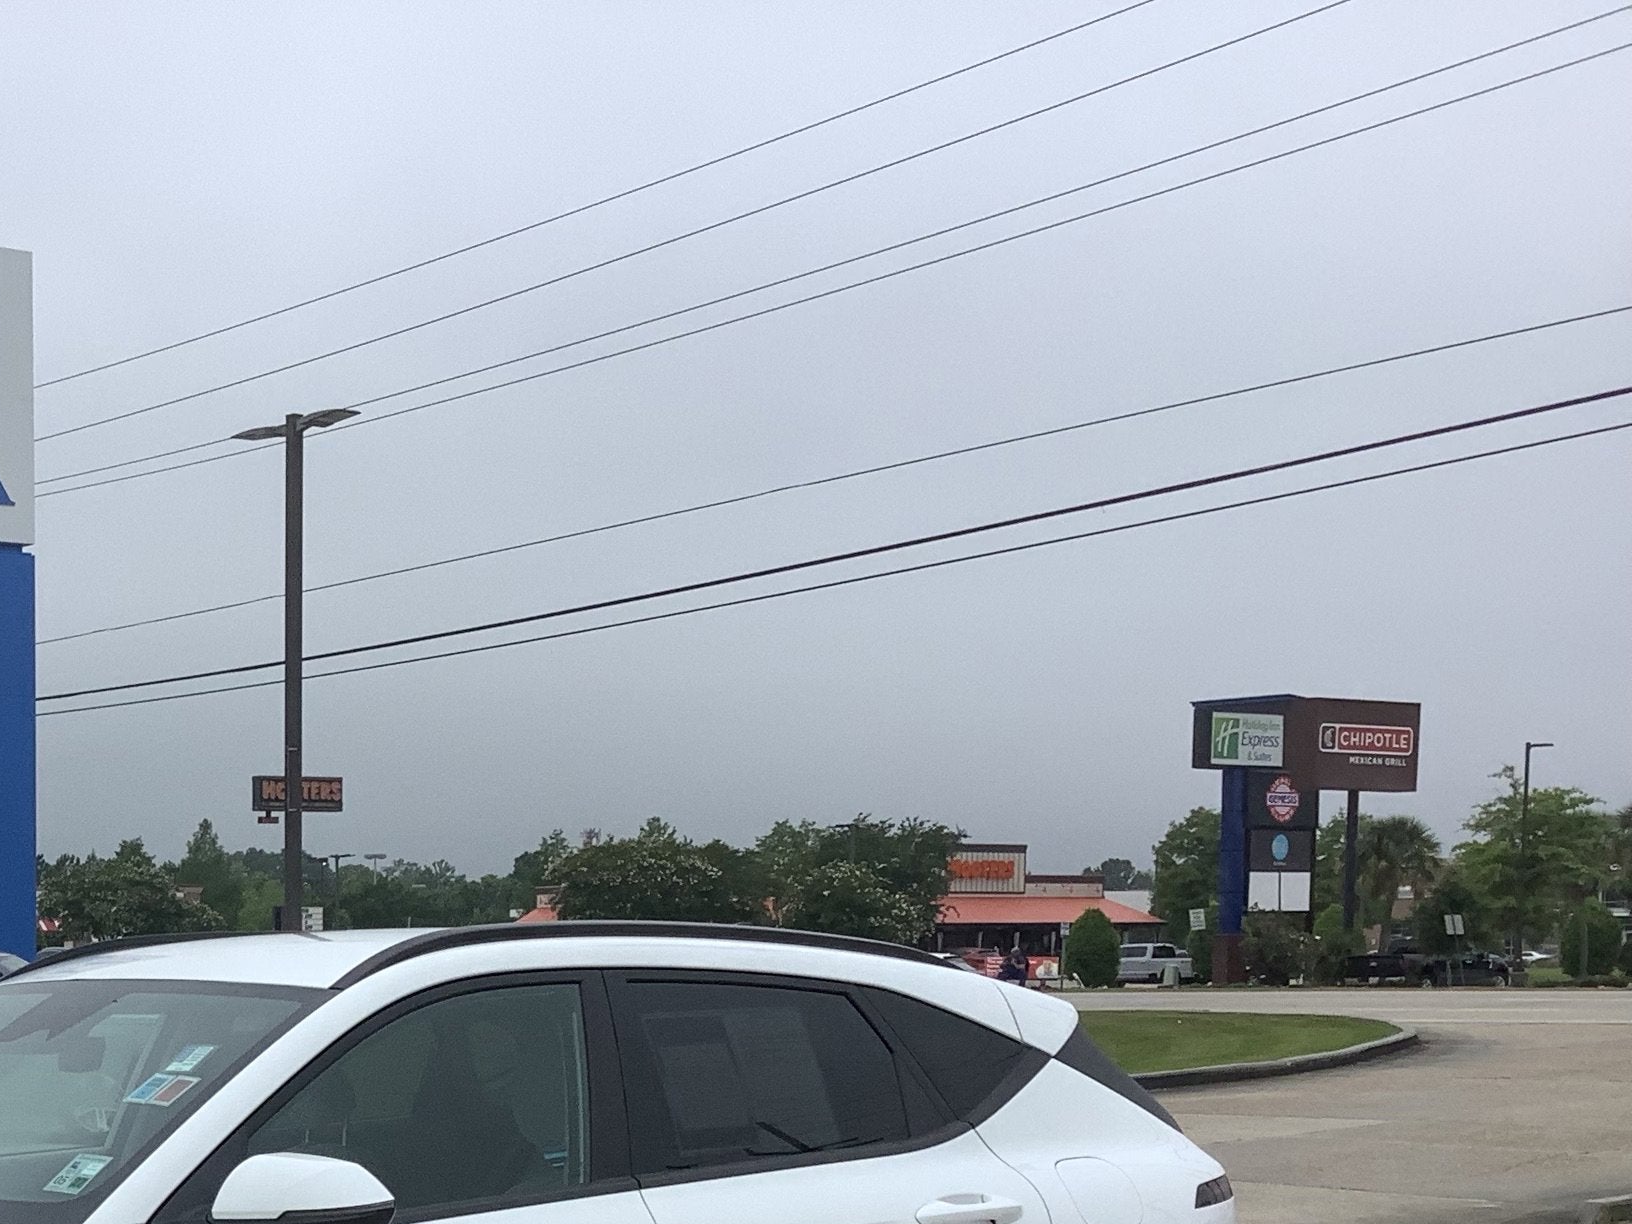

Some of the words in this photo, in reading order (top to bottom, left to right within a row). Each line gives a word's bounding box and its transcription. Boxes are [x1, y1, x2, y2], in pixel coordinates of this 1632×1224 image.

[1241, 731, 1279, 749] Express
[1340, 731, 1409, 748] CHIPOTLE
[1349, 756, 1383, 765] MEXICAN
[1384, 757, 1407, 767] GRILL
